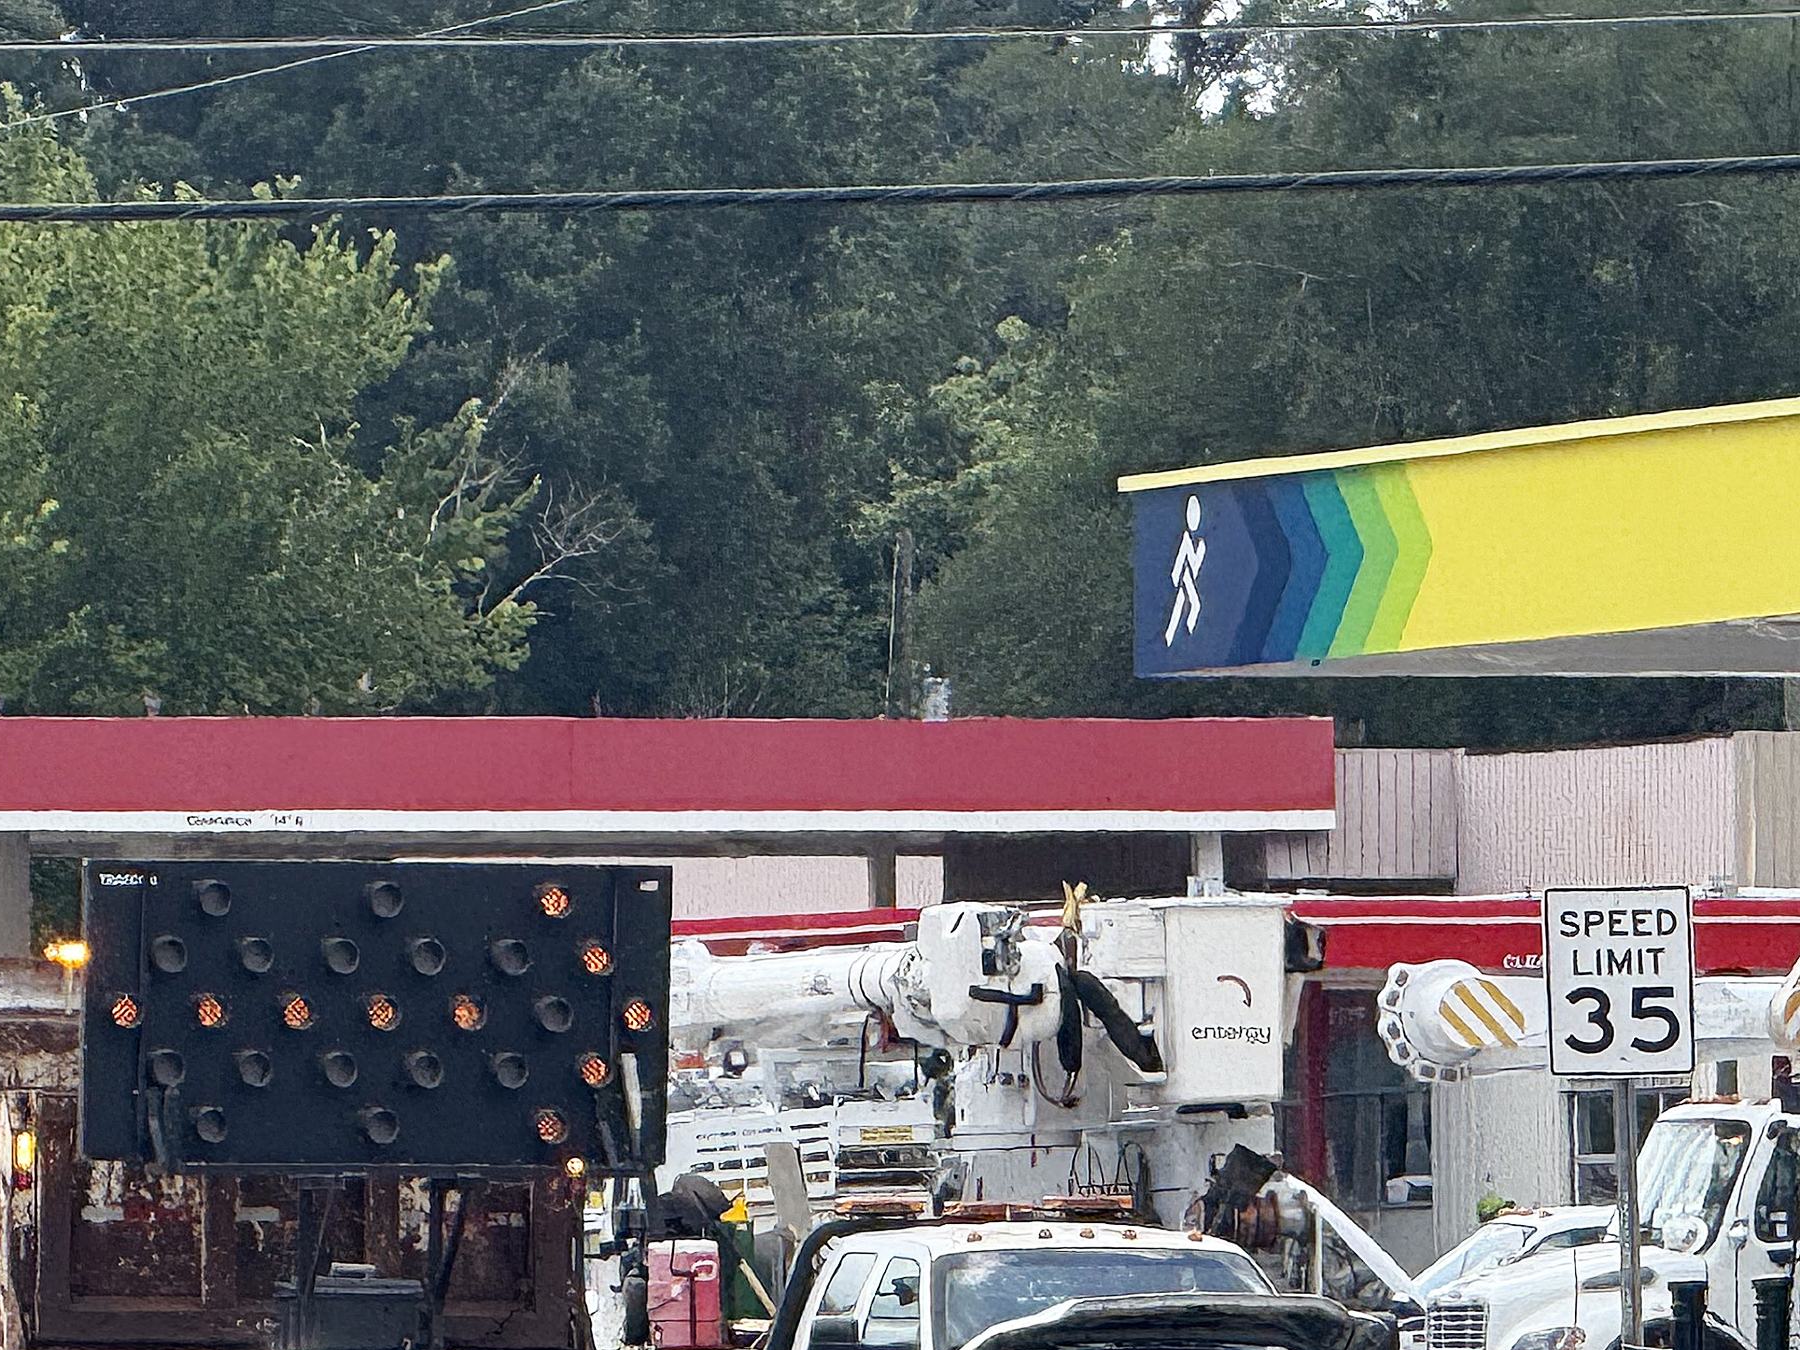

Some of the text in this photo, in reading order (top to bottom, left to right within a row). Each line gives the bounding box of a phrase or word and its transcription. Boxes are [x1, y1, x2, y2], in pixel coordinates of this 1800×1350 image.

[1560, 909, 1678, 937] SPEED
[1573, 948, 1665, 976] LIMIT
[1565, 987, 1680, 1054] 35
